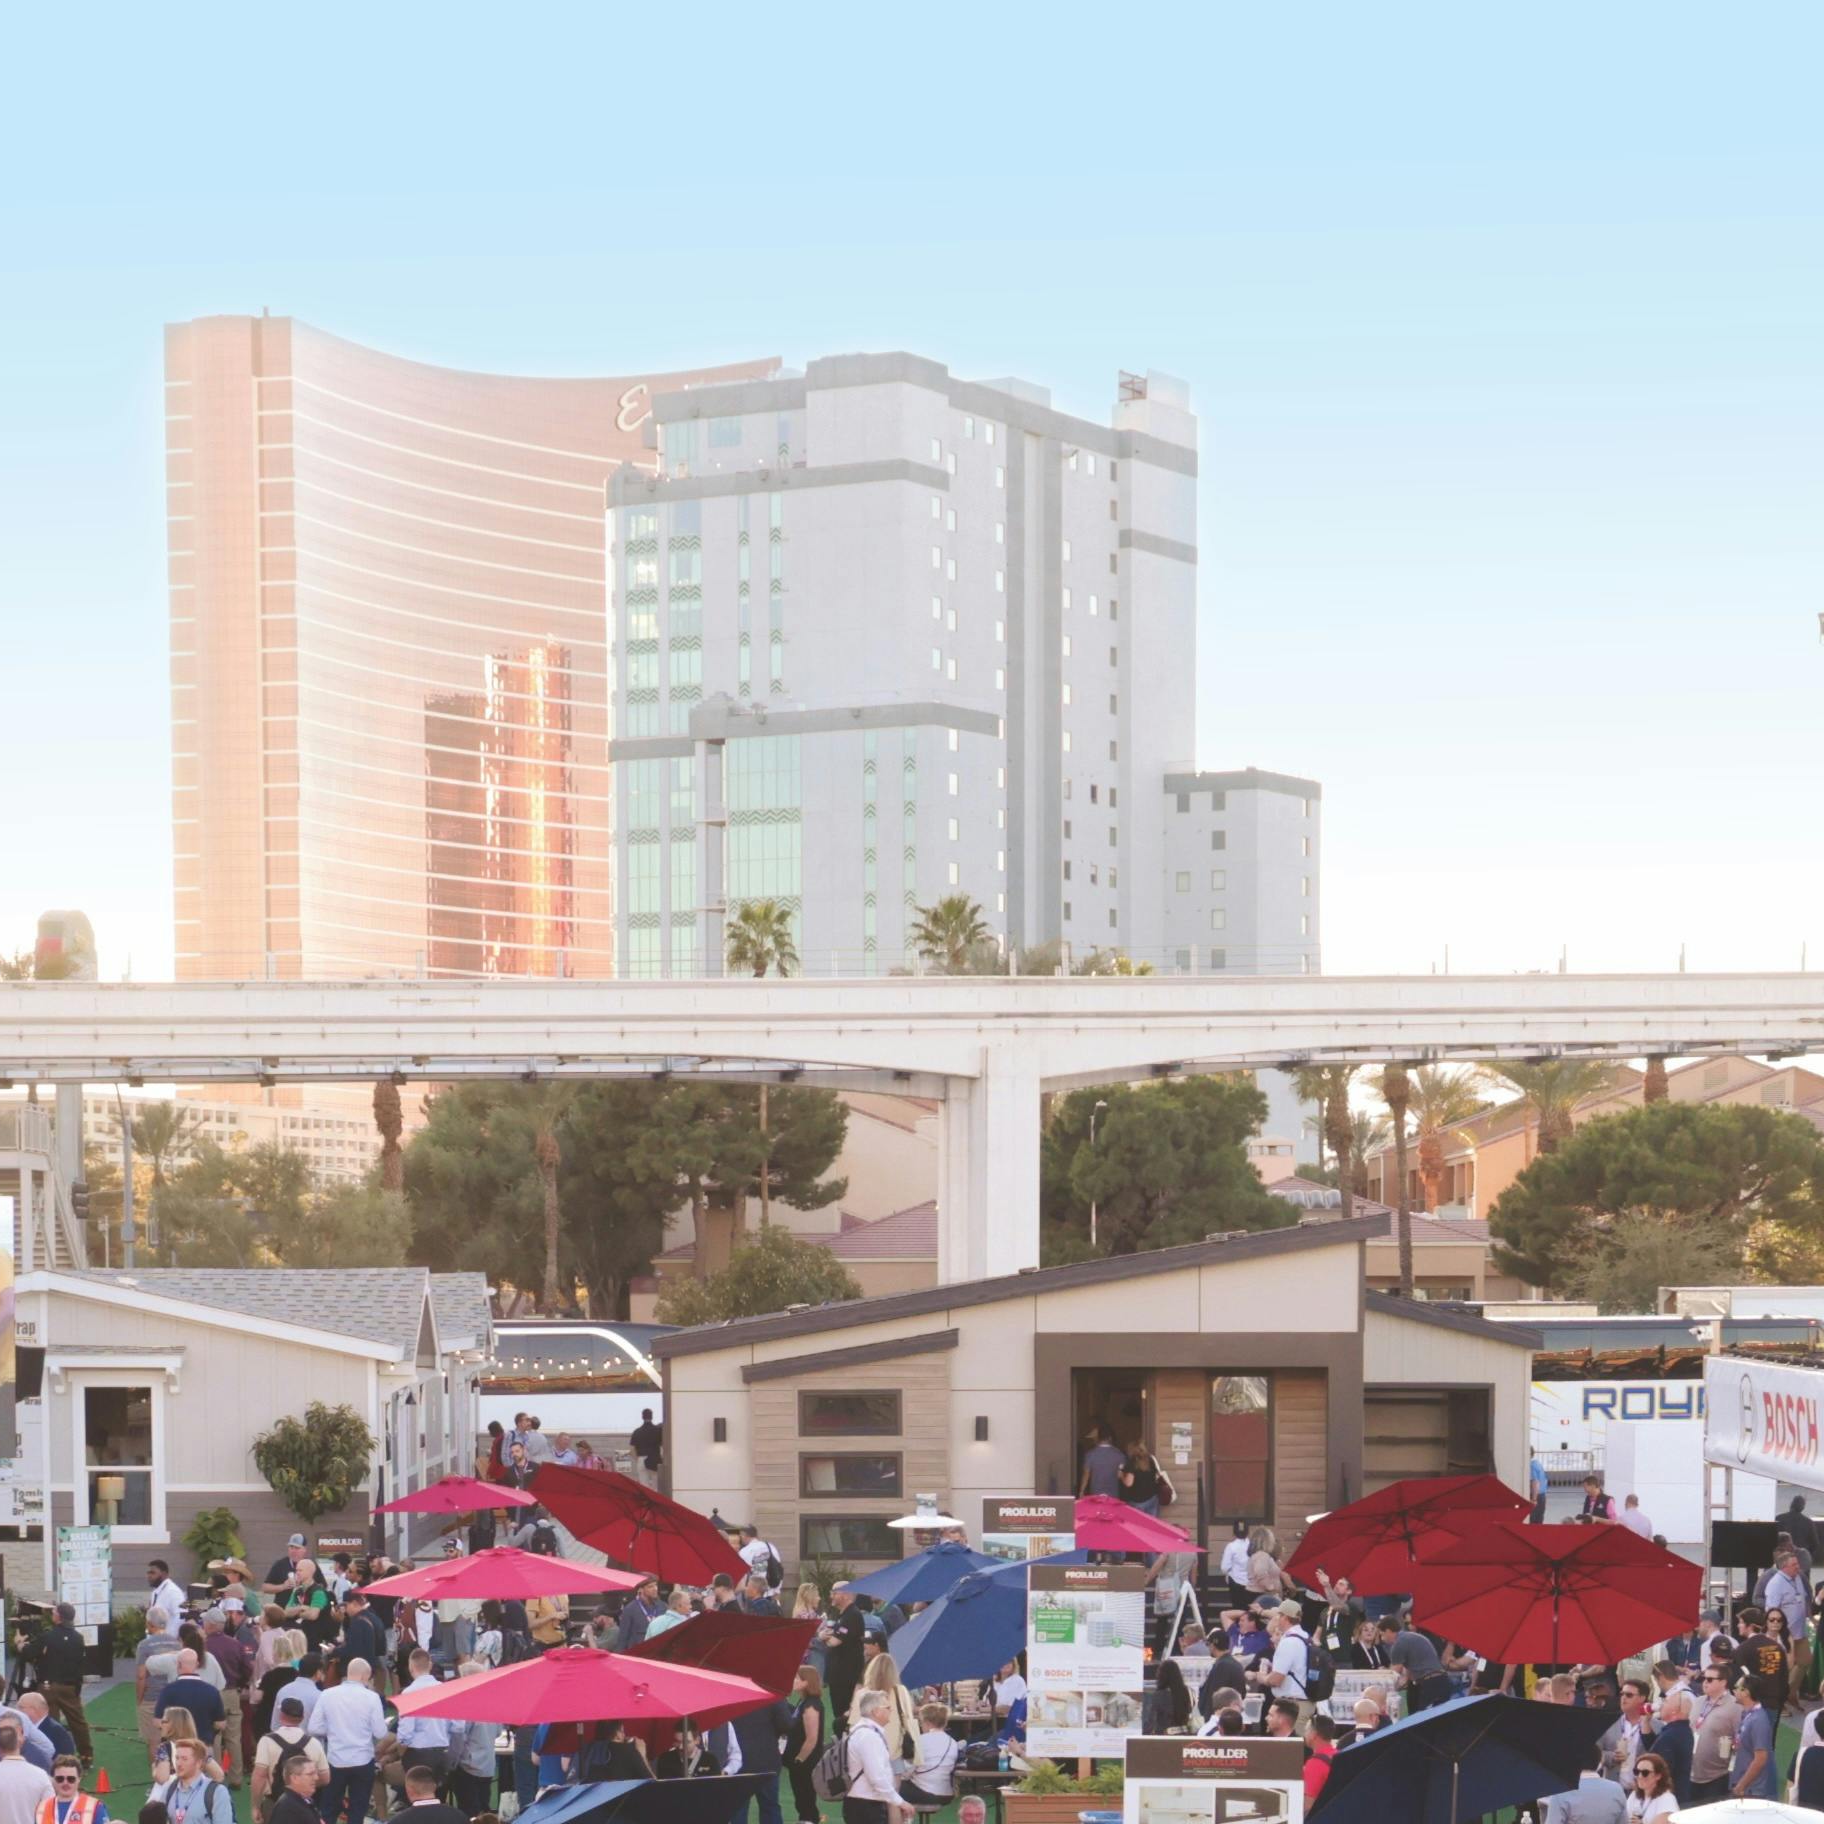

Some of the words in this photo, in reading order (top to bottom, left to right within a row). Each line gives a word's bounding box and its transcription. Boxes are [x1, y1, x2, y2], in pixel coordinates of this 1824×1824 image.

[1583, 1387, 1705, 1420] ROY
[1762, 1391, 1819, 1466] BOSCH
[999, 1507, 1057, 1517] PROBUILDER
[1065, 1571, 1109, 1579] PROBUILDER
[1044, 1669, 1073, 1678] BOSCH
[1183, 1748, 1248, 1758] PROBUILDER
